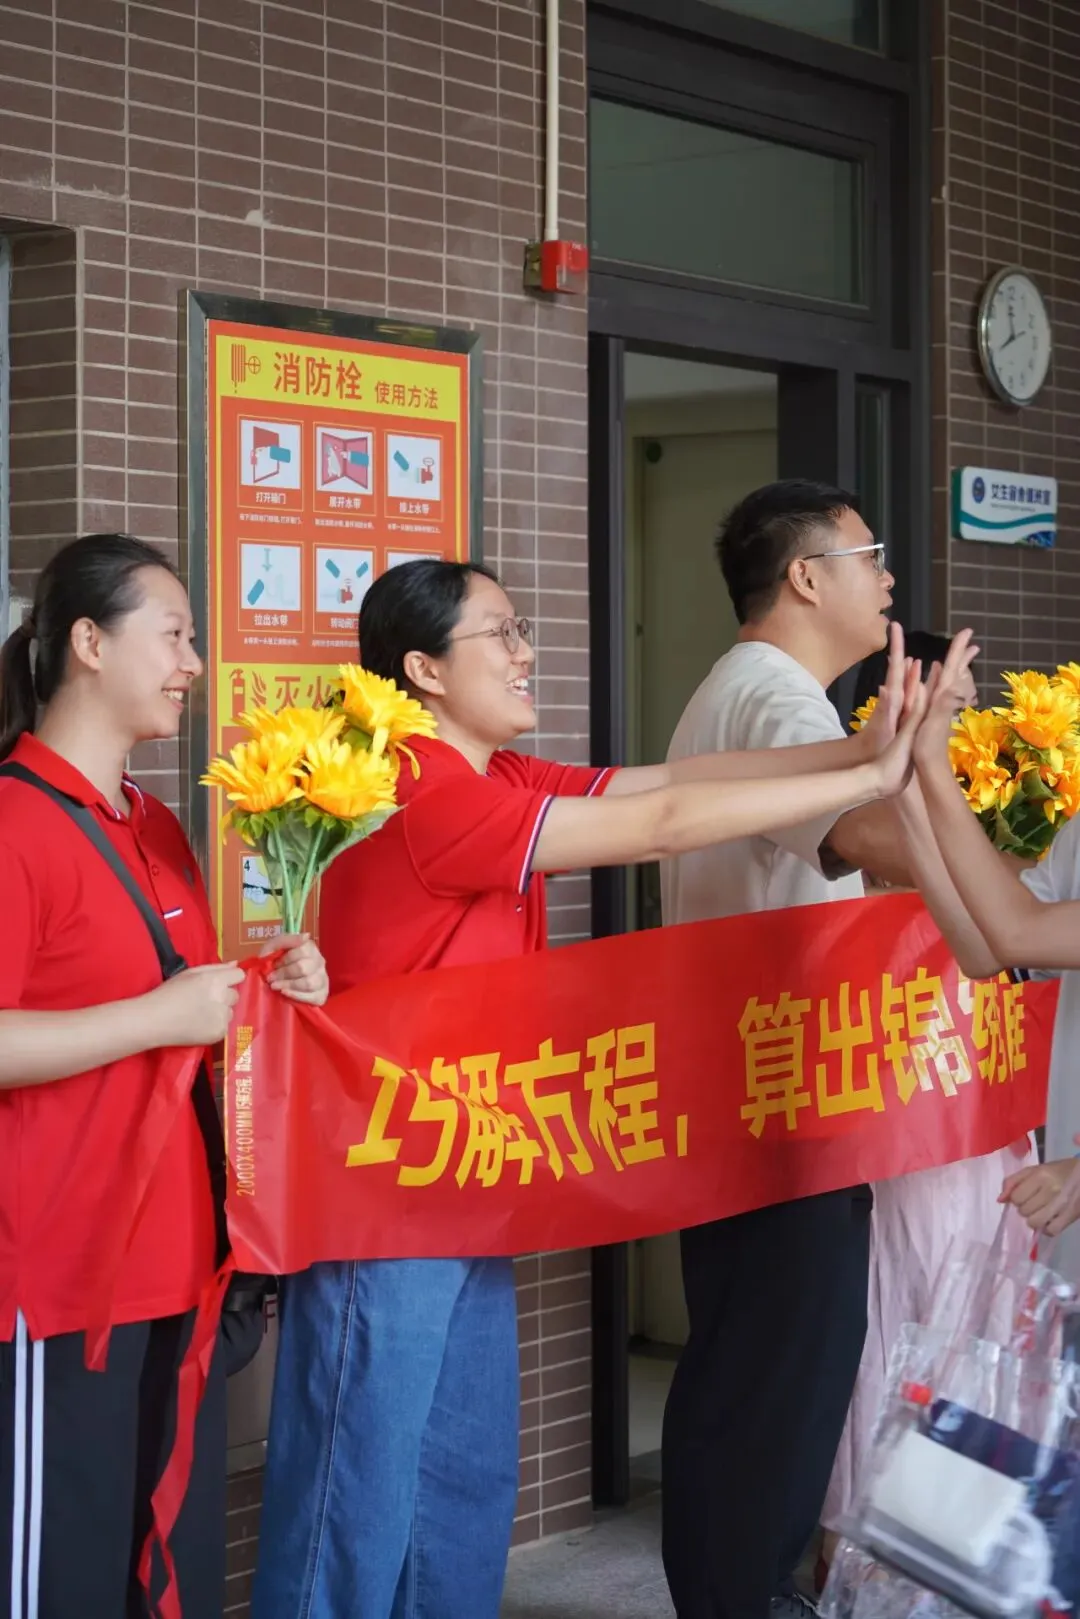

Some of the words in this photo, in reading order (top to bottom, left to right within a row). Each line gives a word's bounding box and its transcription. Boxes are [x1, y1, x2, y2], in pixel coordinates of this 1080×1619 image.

[273, 351, 362, 400] 消防栓
[375, 380, 439, 410] 使用方法
[243, 860, 251, 872] 4
